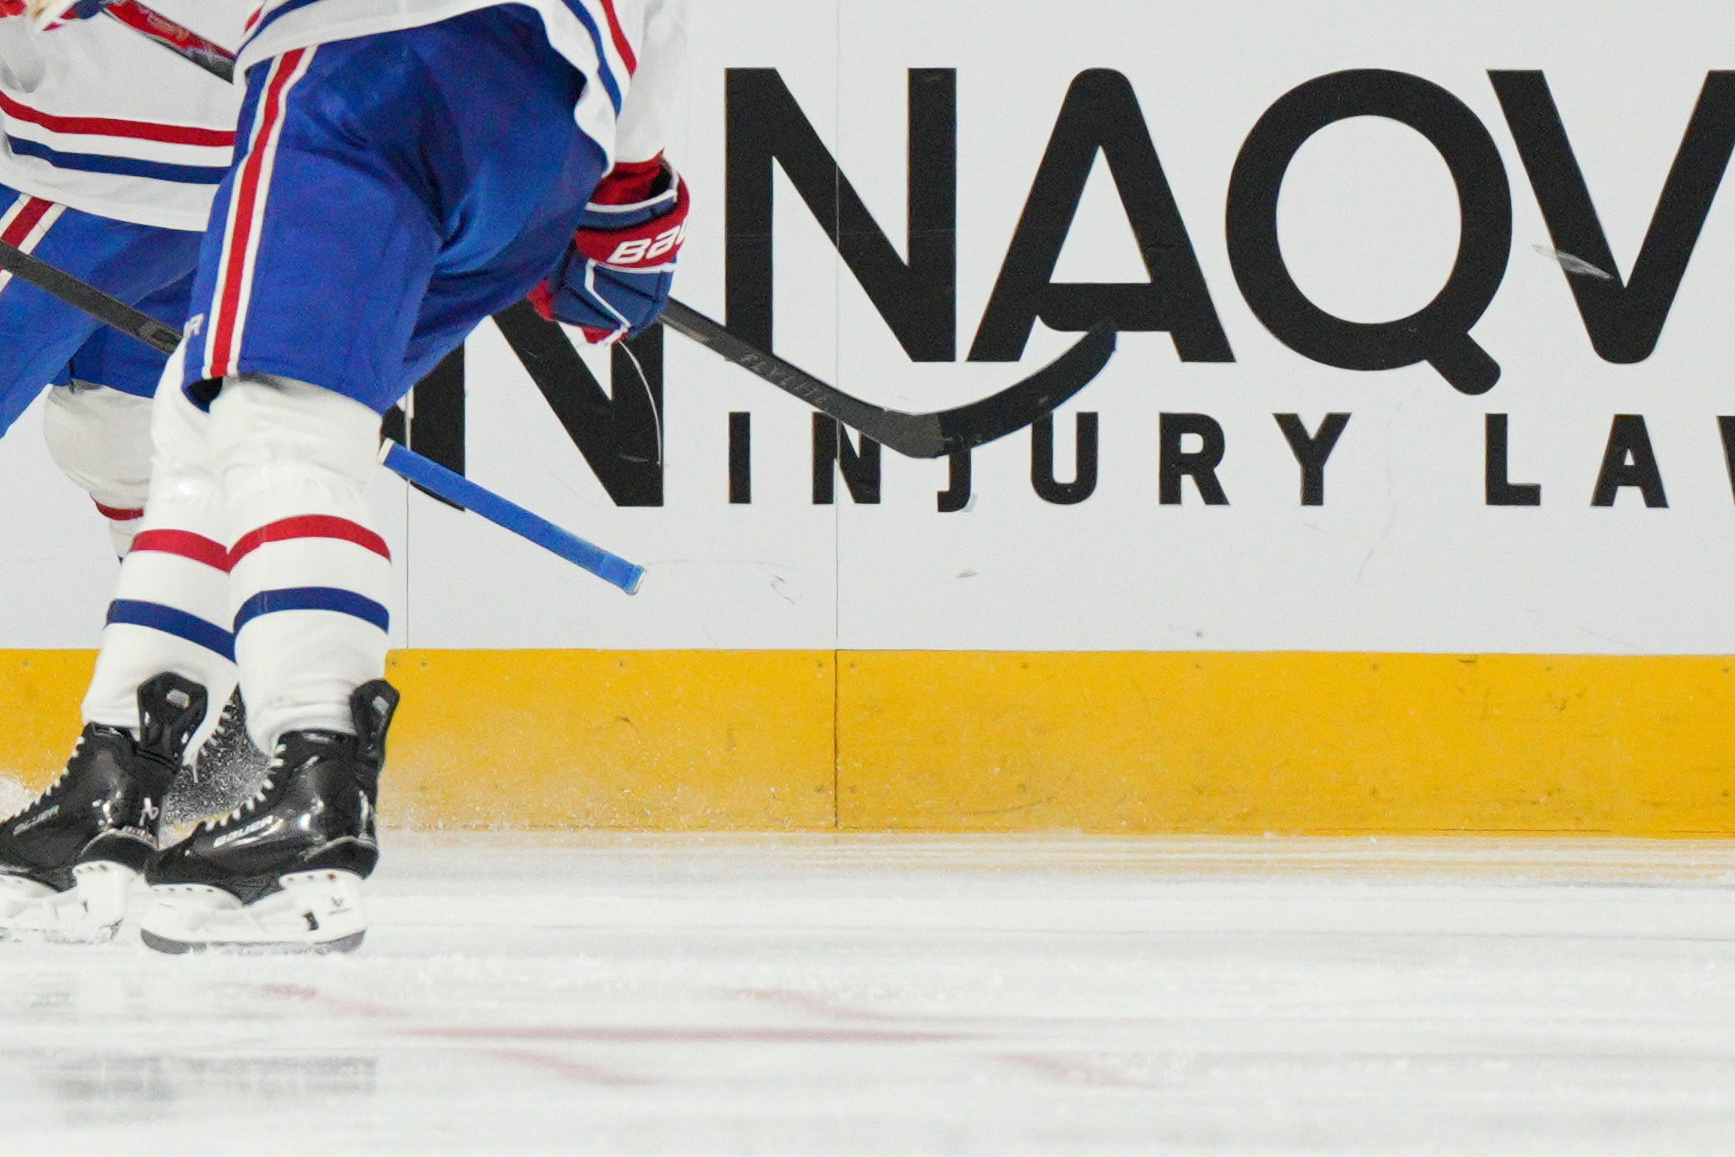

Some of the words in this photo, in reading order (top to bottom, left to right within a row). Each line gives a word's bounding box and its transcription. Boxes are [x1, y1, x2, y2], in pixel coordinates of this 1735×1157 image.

[725, 68, 1735, 395] NAQV
[728, 411, 1351, 513] INJURY
[1485, 413, 1735, 509] LA
